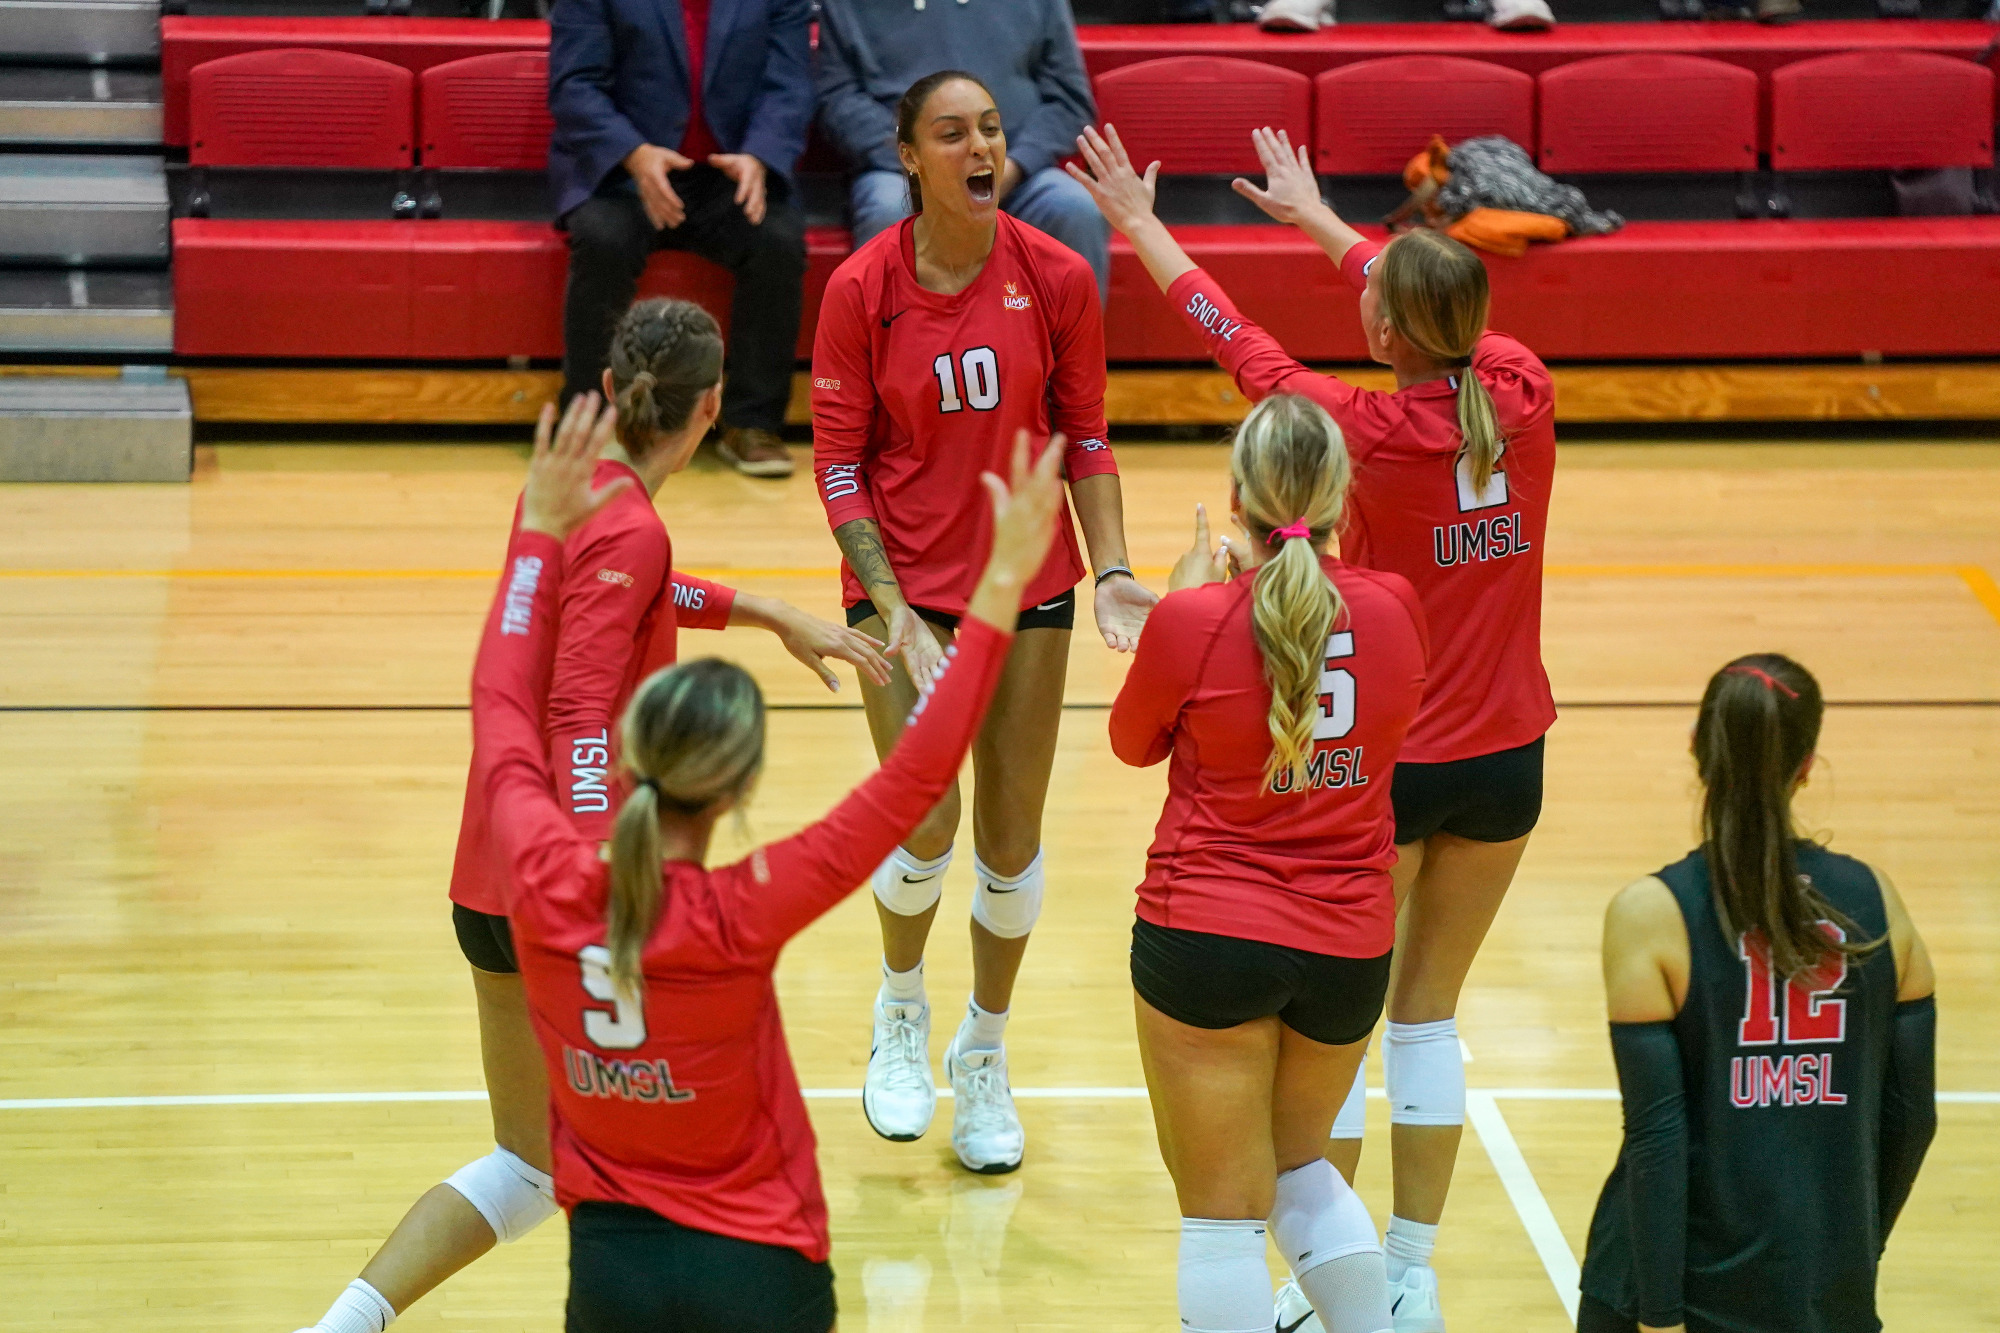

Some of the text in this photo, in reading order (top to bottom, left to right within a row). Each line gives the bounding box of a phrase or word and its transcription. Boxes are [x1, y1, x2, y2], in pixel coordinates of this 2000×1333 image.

[1003, 295, 1031, 310] UMSL
[932, 345, 1001, 414] 10
[1454, 437, 1509, 513] 2
[1433, 512, 1531, 567] UMSL
[1311, 629, 1358, 742] 5
[571, 727, 609, 814] UMSL
[1269, 746, 1369, 794] UMSL
[1737, 918, 1848, 1046] 12
[563, 1043, 697, 1103] UMSL
[1729, 1053, 1848, 1109] UMSL
